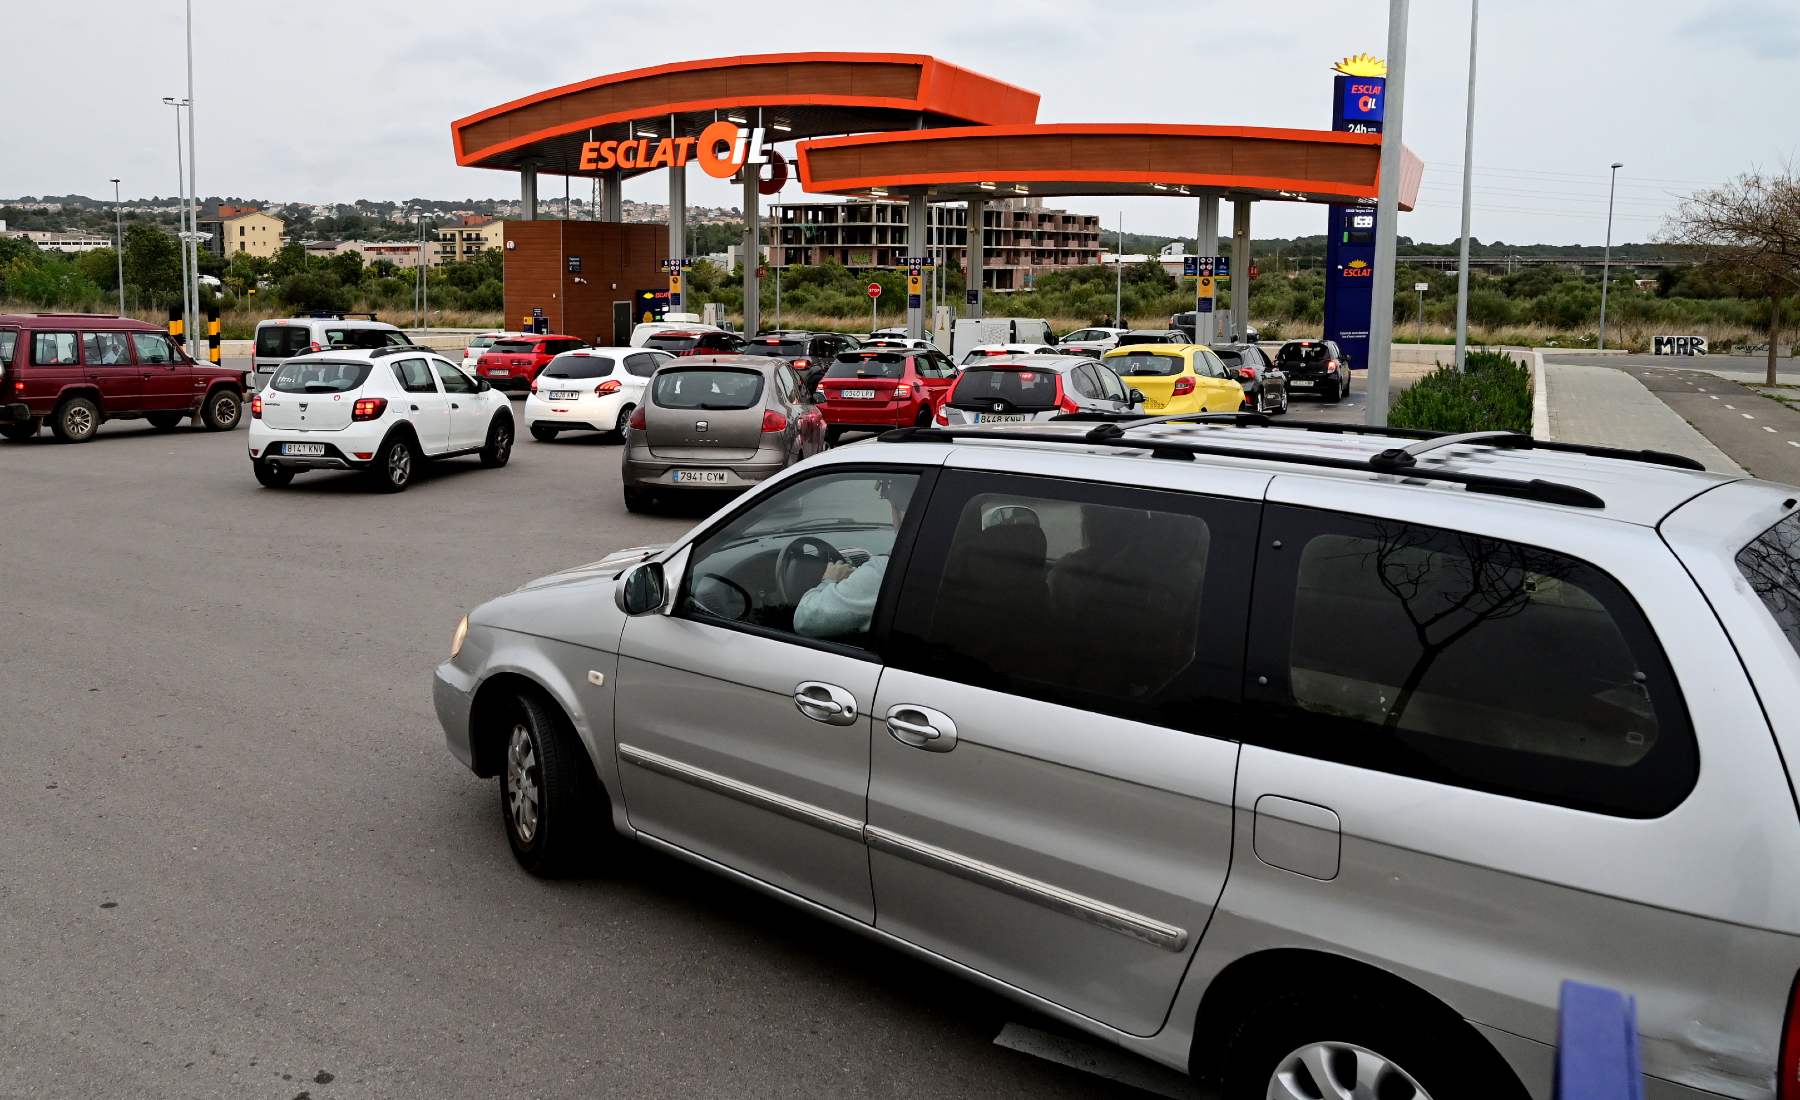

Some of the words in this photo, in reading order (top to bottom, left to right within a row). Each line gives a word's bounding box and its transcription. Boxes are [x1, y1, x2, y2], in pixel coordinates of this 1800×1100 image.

[1351, 84, 1382, 95] ESCLAT
[579, 136, 696, 170] ESCLAT
[1343, 268, 1372, 277] ESCLAT
[288, 443, 306, 453] 8141
[680, 471, 703, 481] 7941
